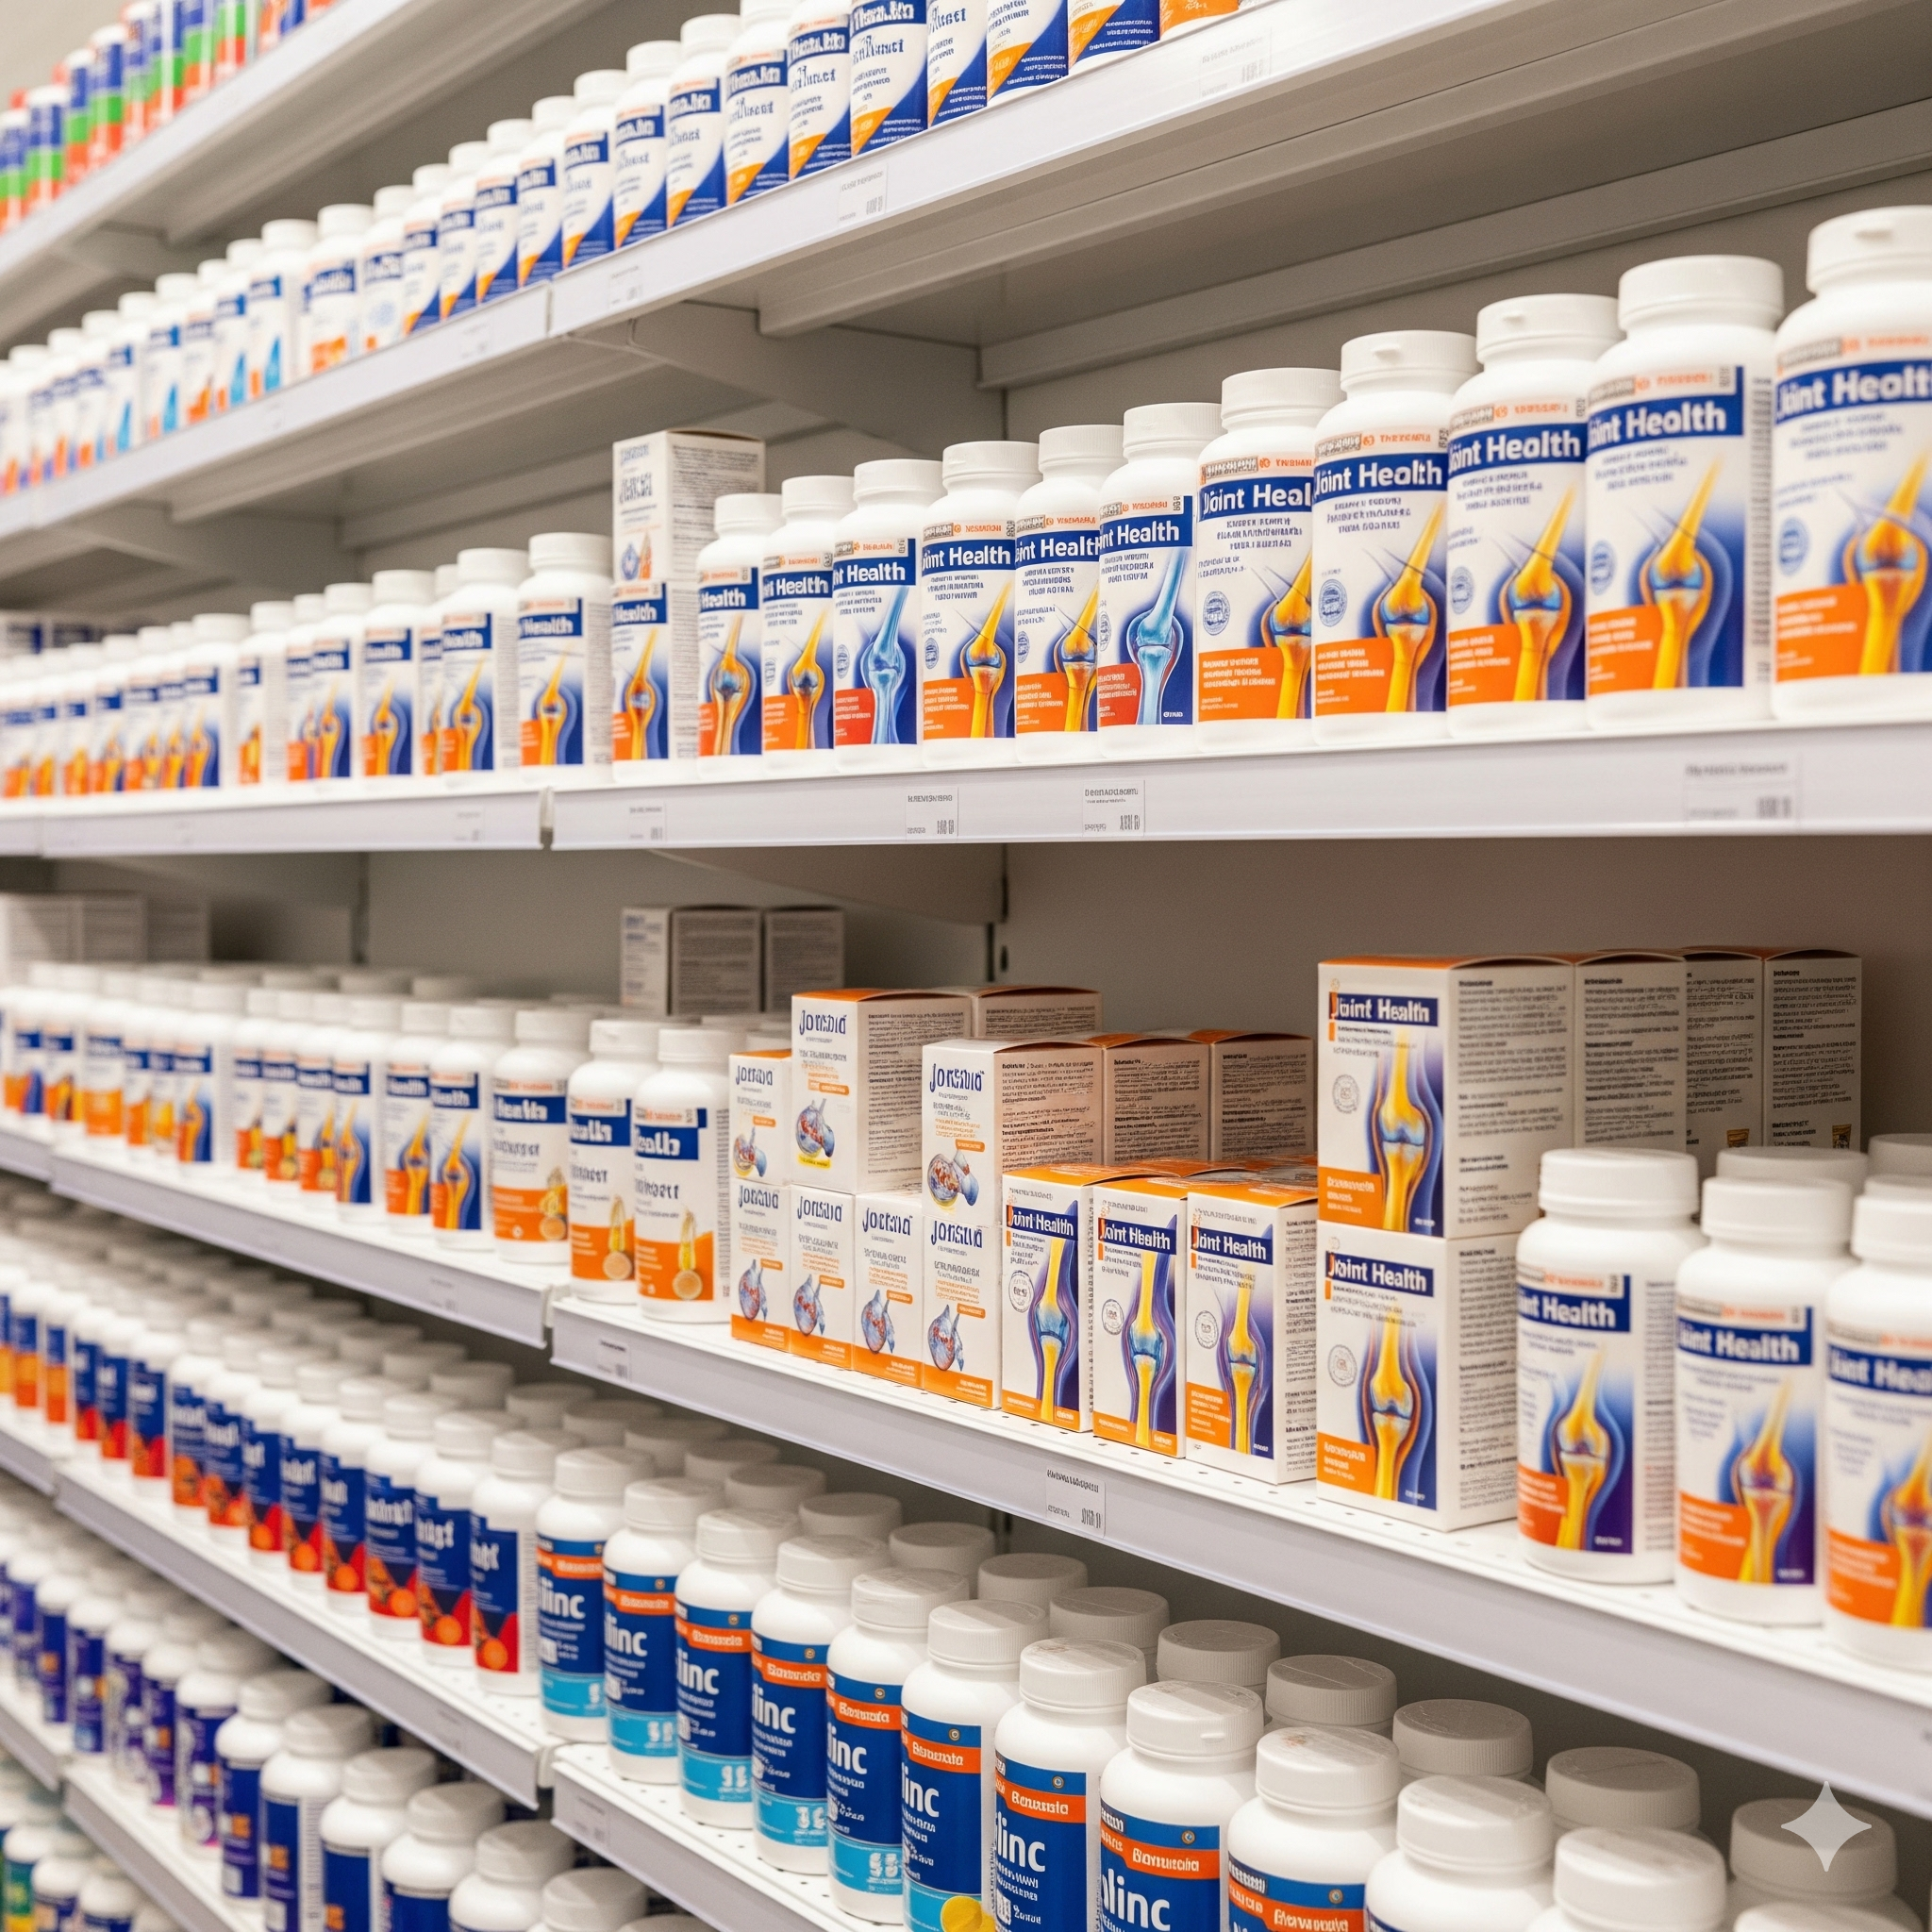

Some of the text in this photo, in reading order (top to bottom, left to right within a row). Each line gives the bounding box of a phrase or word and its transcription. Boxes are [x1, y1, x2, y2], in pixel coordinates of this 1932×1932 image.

[1832, 365, 1932, 406] Healt
[1625, 400, 1727, 440] Health
[1487, 429, 1581, 463] Health
[1358, 458, 1442, 488] Health
[1253, 482, 1311, 508] Heal
[1117, 520, 1179, 545] Health
[949, 545, 1011, 566] Health
[847, 562, 906, 583] Health
[1331, 992, 1430, 1024] Joint Health
[1129, 1227, 1171, 1251] Health
[1224, 1236, 1267, 1260] Health
[1372, 1262, 1427, 1292] Health
[1541, 1294, 1616, 1329] Health
[1715, 1330, 1800, 1363] Health
